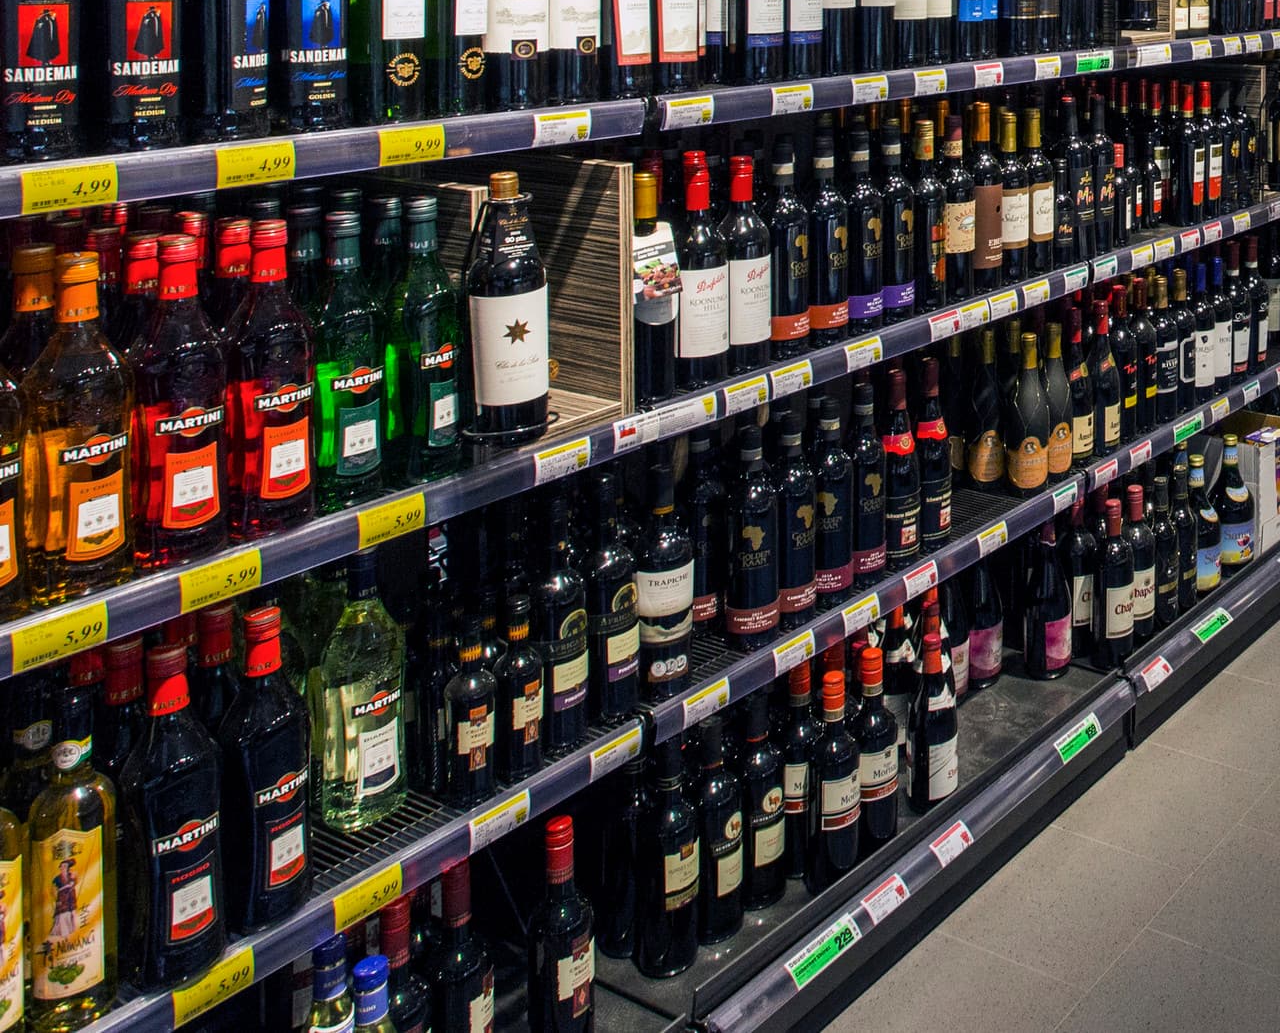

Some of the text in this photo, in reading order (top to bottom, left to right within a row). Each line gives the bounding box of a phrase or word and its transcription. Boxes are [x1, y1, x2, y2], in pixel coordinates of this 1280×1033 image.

[290, 48, 347, 64] SANDEMAN
[5, 65, 78, 84] SANDEMAN
[113, 59, 179, 76] SANDEMAN
[27, 118, 62, 126] MEDIUM
[134, 109, 166, 117] MEDIUM
[414, 138, 441, 153] 9,99
[258, 156, 291, 173] 4,99
[72, 178, 112, 197] 4,99
[334, 370, 383, 390] MARTINI
[258, 386, 311, 410] MARTINI
[160, 411, 221, 433] MARTINI
[63, 436, 128, 463] MARTINI
[394, 509, 421, 529] 5,99
[223, 565, 257, 589] 5,99
[648, 572, 688, 588] TRAPICHE
[64, 621, 103, 647] 5,99
[259, 770, 308, 804] MARTINI
[158, 816, 217, 853] MARTINI
[370, 879, 399, 905] 5,99
[218, 965, 251, 993] 5,99
